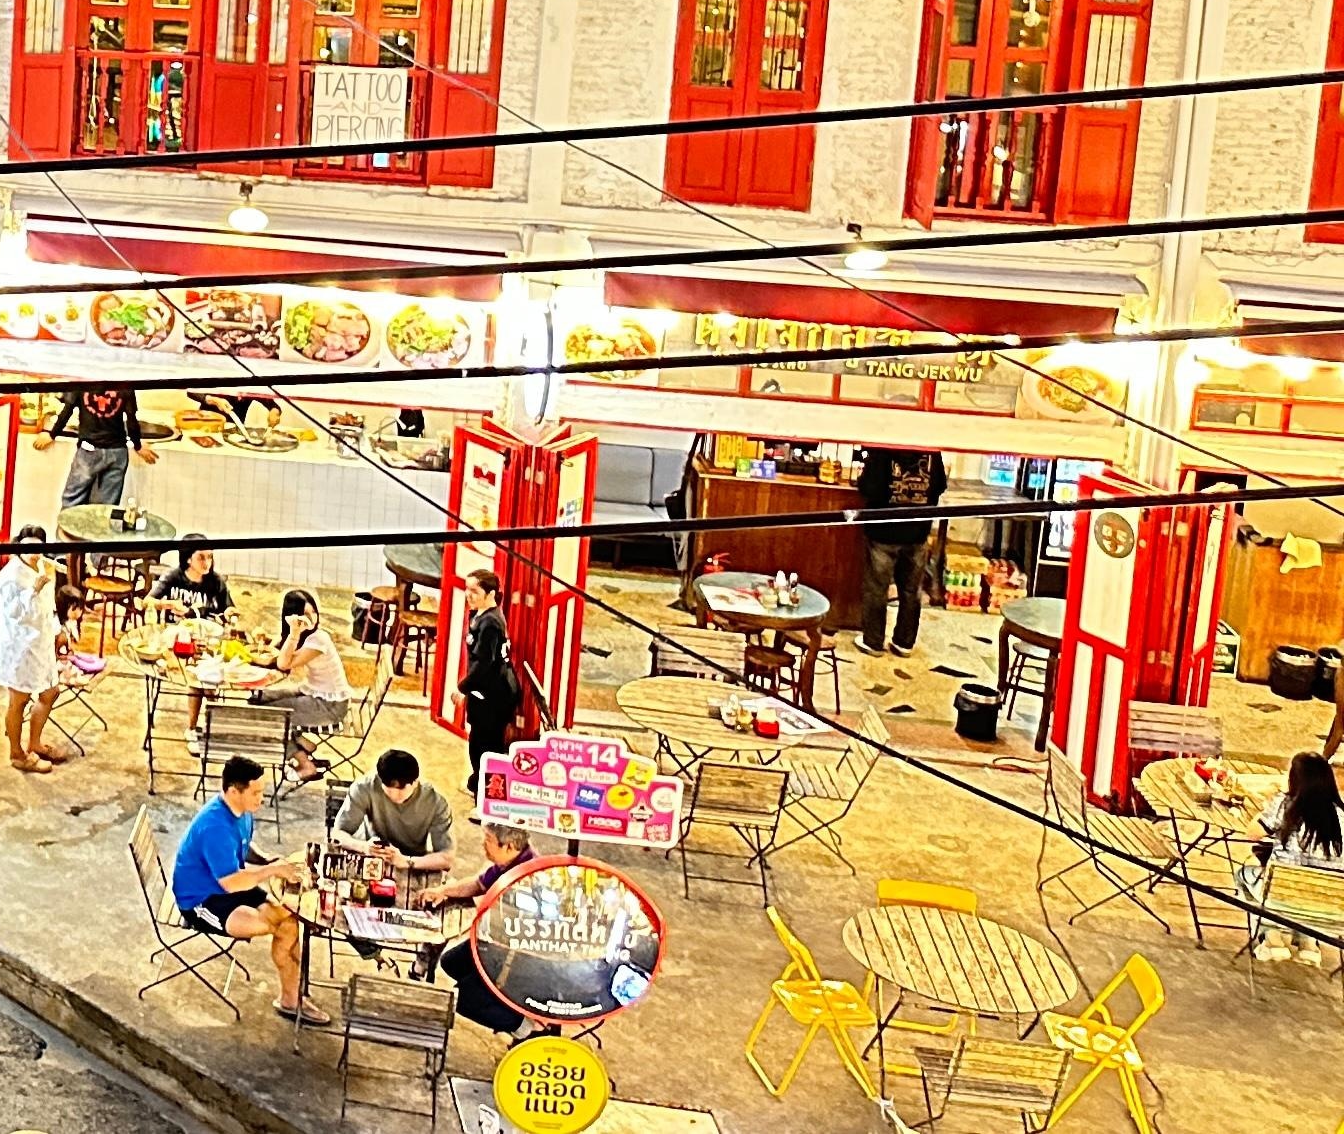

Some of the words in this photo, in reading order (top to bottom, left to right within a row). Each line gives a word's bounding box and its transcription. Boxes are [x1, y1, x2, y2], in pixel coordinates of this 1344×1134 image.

[319, 72, 403, 103] TATTOO
[315, 115, 403, 144] PIERCING
[866, 360, 915, 378] TANG
[916, 364, 952, 380] JEK
[952, 367, 984, 382] WU
[548, 752, 583, 764] CHULA
[586, 745, 619, 767] 14
[509, 938, 578, 953] BANTHAT
[520, 1057, 586, 1082] อร่อย
[516, 1079, 586, 1099] ตลอด
[525, 1097, 575, 1116] แนว
